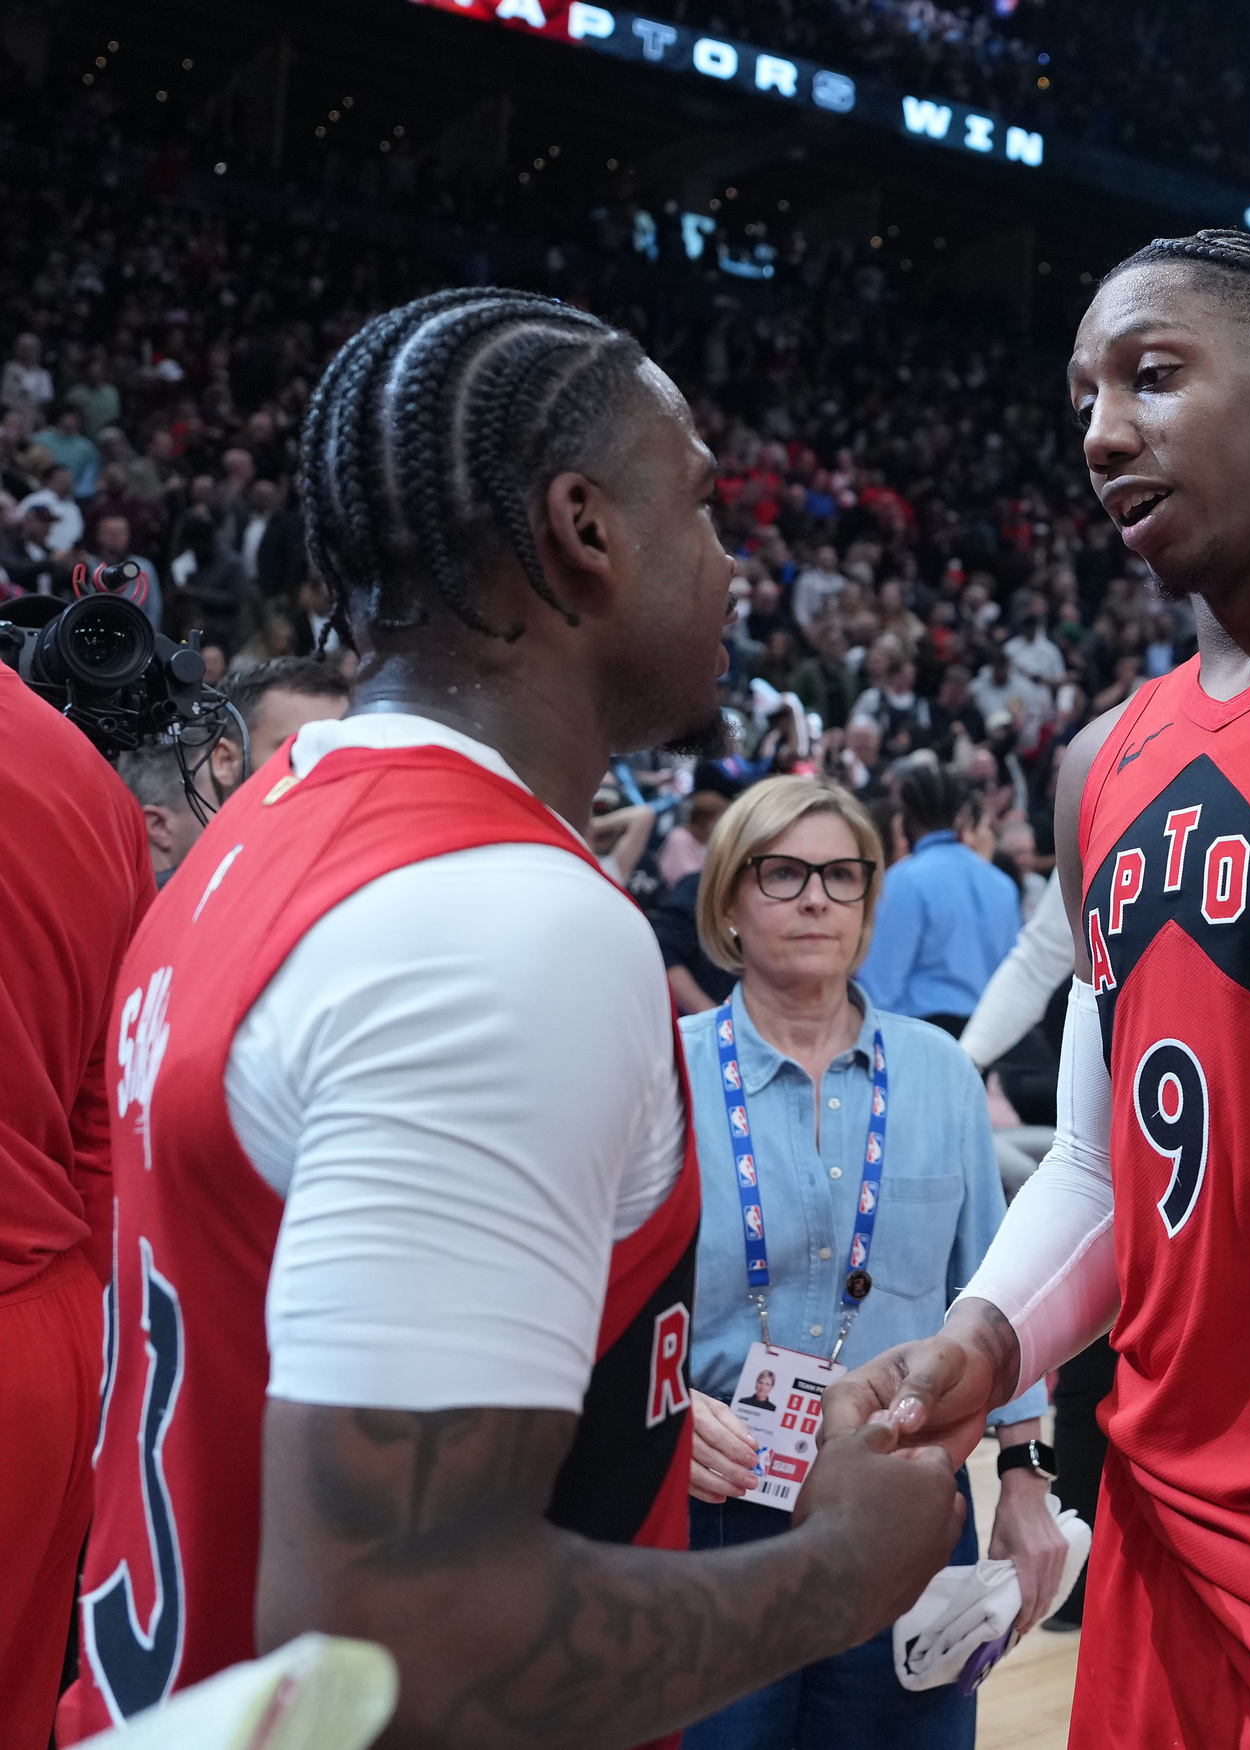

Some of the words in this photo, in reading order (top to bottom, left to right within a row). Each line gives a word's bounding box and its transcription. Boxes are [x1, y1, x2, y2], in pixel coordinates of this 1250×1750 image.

[440, 0, 857, 114] APTORS
[902, 95, 1045, 168] WIN
[1132, 1037, 1210, 1240] 9
